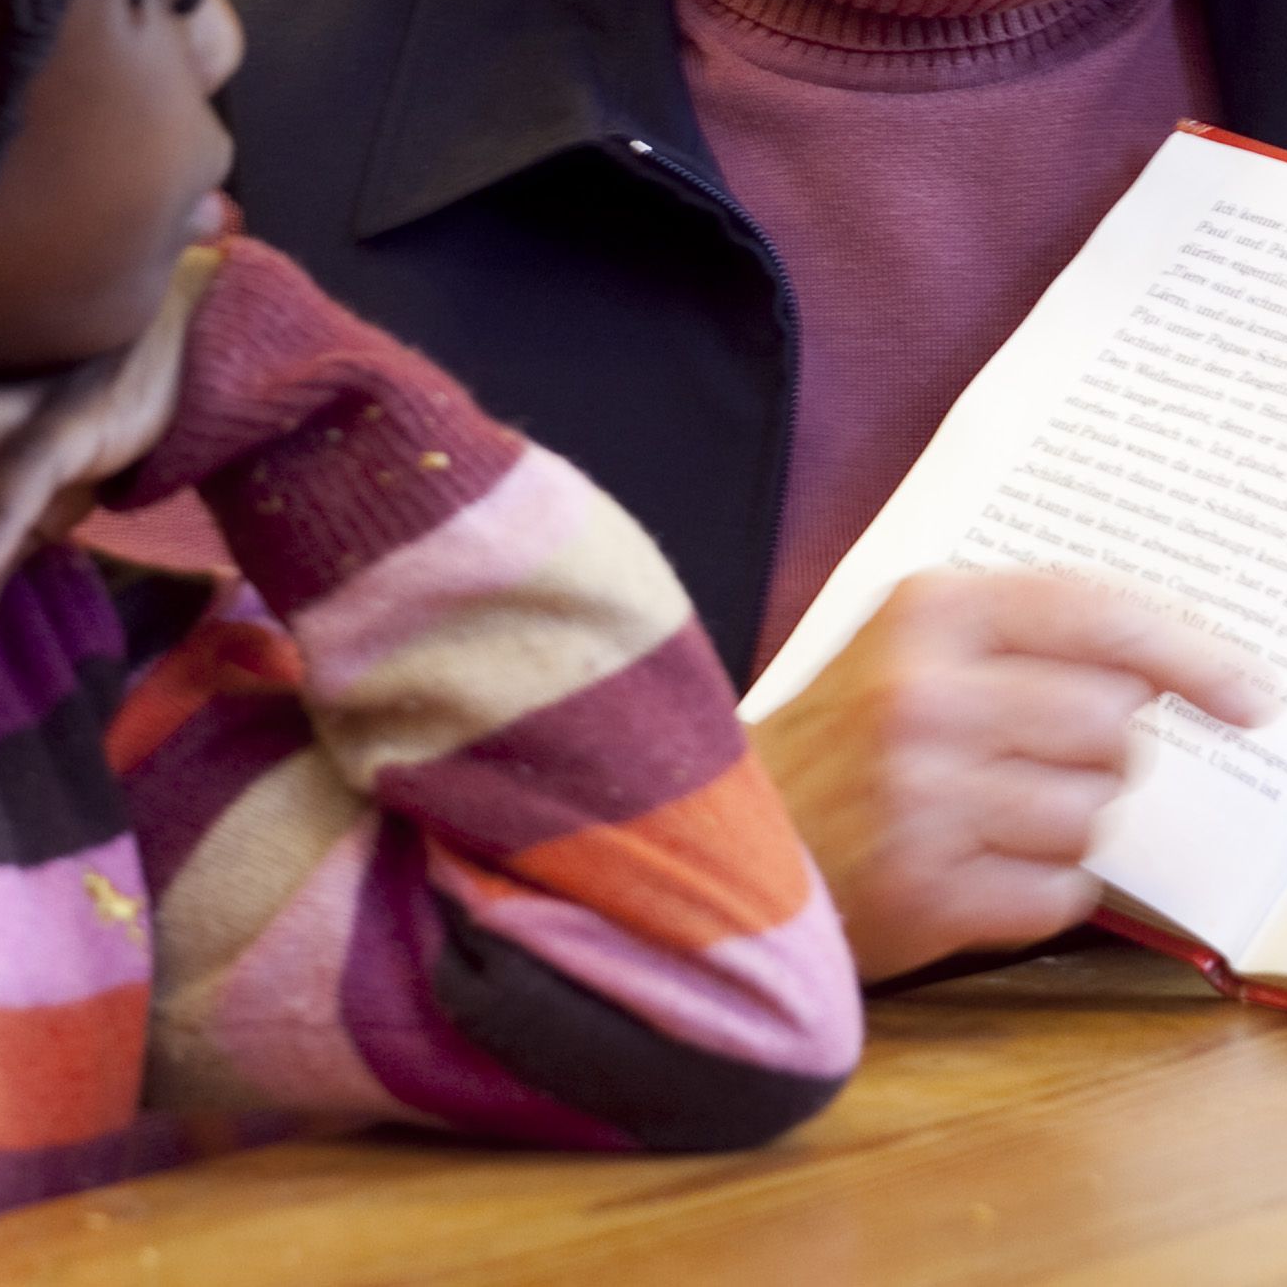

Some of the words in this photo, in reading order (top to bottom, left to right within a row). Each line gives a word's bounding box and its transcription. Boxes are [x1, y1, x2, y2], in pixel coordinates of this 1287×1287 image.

[1193, 218, 1233, 240] Paul
[1231, 233, 1268, 251] und
[1235, 206, 1285, 231] kenne
[1207, 279, 1247, 300] sind
[1192, 303, 1228, 322] und
[1221, 314, 1248, 329] sie
[1096, 347, 1131, 371] Den
[1170, 351, 1202, 368] mit
[1199, 358, 1236, 380] dem
[1203, 331, 1253, 358] Papas
[1063, 394, 1120, 421] storben.
[1123, 412, 1183, 442] Einfach
[1079, 372, 1122, 395] nicht
[1119, 384, 1161, 408] lange
[1214, 416, 1256, 440] denn
[1029, 434, 1069, 458] Paul
[1065, 447, 1095, 467] hat
[1092, 458, 1126, 478] sich
[1124, 469, 1167, 494] dann
[1165, 486, 1201, 507] eine
[1046, 416, 1082, 435] und
[1075, 423, 1123, 449] Paula
[1122, 441, 1169, 466] waren
[1168, 456, 1192, 475] da
[1190, 467, 1234, 490] nicht
[1011, 460, 1113, 504] „Schildkröten
[1112, 496, 1174, 528] machen
[1173, 516, 1255, 558] überhaupt
[995, 482, 1033, 504] man
[1031, 491, 1073, 519] kann
[1071, 510, 1097, 528] sie
[1094, 515, 1140, 544] leicht
[1233, 569, 1264, 592] hat
[979, 502, 1006, 524] Da
[1003, 512, 1034, 535] hat
[1031, 523, 1065, 547] ihm
[1063, 539, 1097, 559] sein
[1100, 547, 1140, 575] Vater
[1165, 574, 1278, 629] Computerspiel
[962, 525, 996, 549] Das
[1174, 608, 1209, 632] Mit
[1208, 620, 1263, 657] Löwen
[1163, 694, 1220, 737] Fenster
[1204, 749, 1257, 790] Unten
